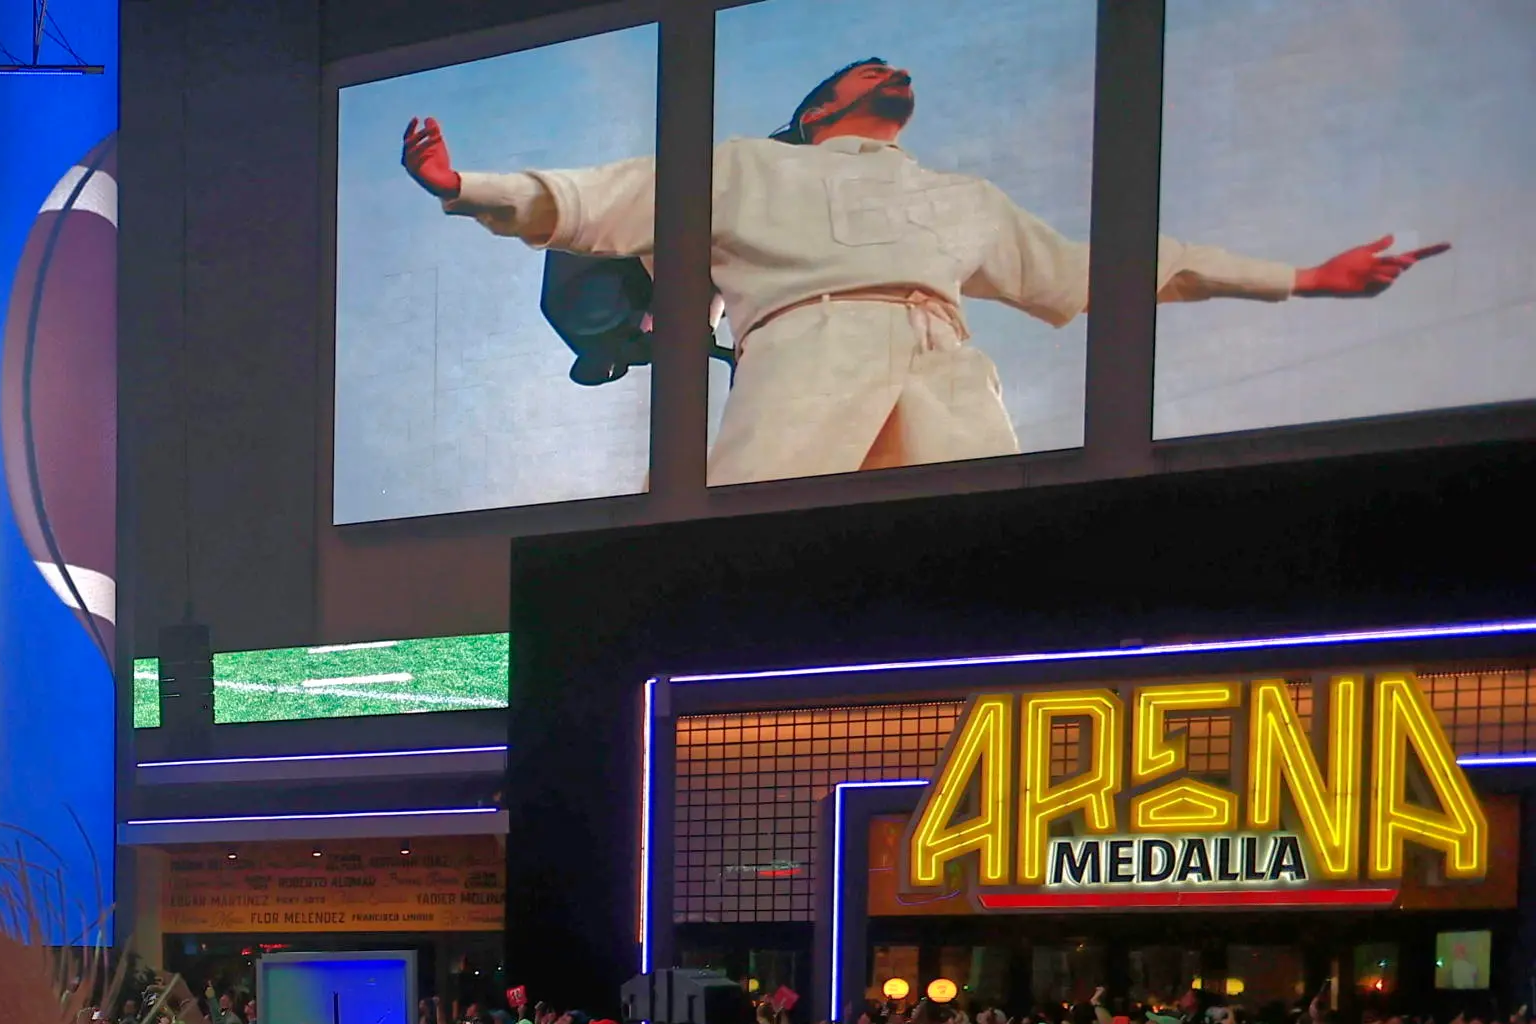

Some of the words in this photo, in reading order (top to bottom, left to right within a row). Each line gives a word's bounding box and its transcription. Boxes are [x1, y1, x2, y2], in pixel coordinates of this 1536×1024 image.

[909, 671, 1488, 886] ARENA
[1049, 834, 1310, 887] MEDALLA
[250, 911, 280, 924] FLOR
[284, 911, 346, 924] MELENDEZ
